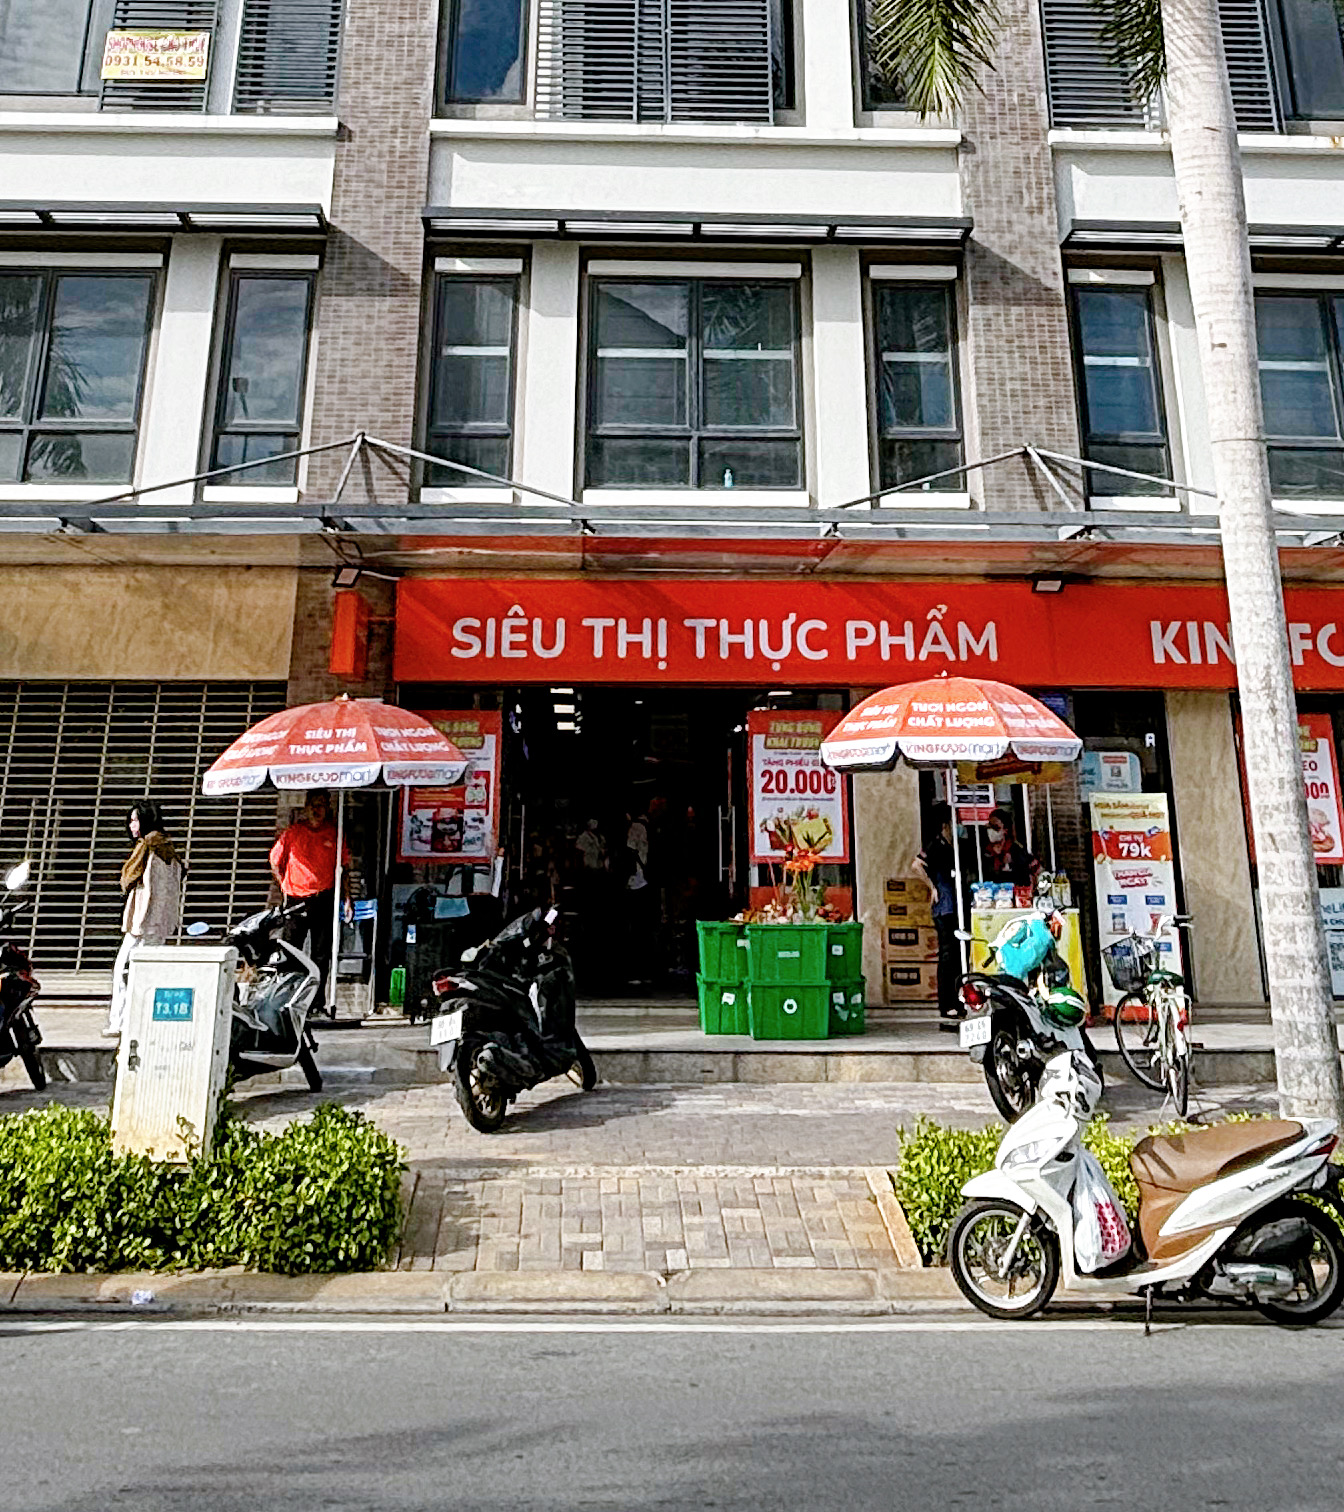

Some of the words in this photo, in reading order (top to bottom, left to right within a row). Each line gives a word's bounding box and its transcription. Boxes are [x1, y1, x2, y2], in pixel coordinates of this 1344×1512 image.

[451, 603, 566, 660] SIÊU
[583, 617, 668, 670] THỊ
[683, 611, 829, 672] THỰC
[845, 603, 999, 663] PHẨM
[1118, 842, 1153, 859] 79k
